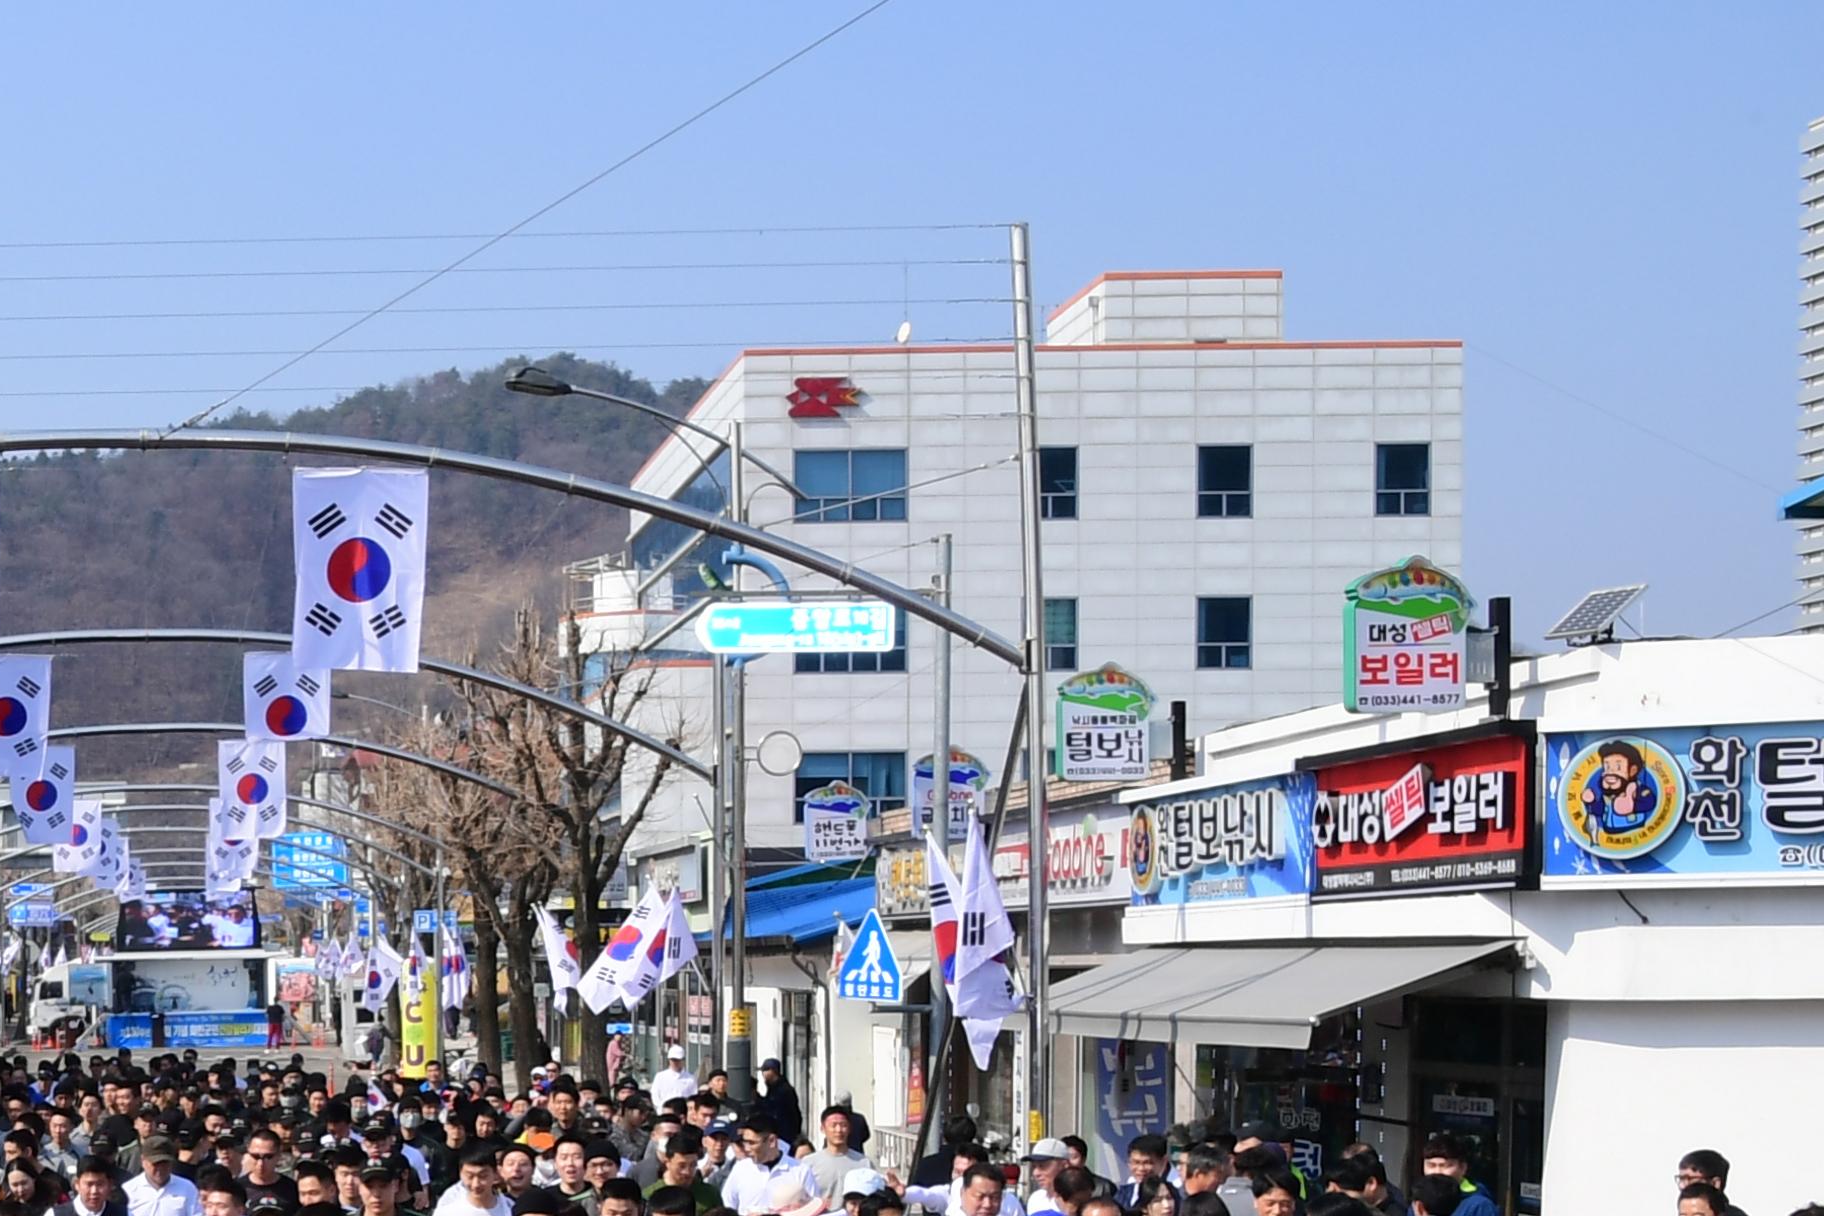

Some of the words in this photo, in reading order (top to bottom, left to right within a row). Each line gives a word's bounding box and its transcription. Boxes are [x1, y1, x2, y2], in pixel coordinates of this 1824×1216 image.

[1368, 624, 1408, 643] 대성
[1359, 652, 1459, 686] 보일러
[1337, 788, 1381, 845] 대성
[1427, 771, 1504, 834] 보일러
